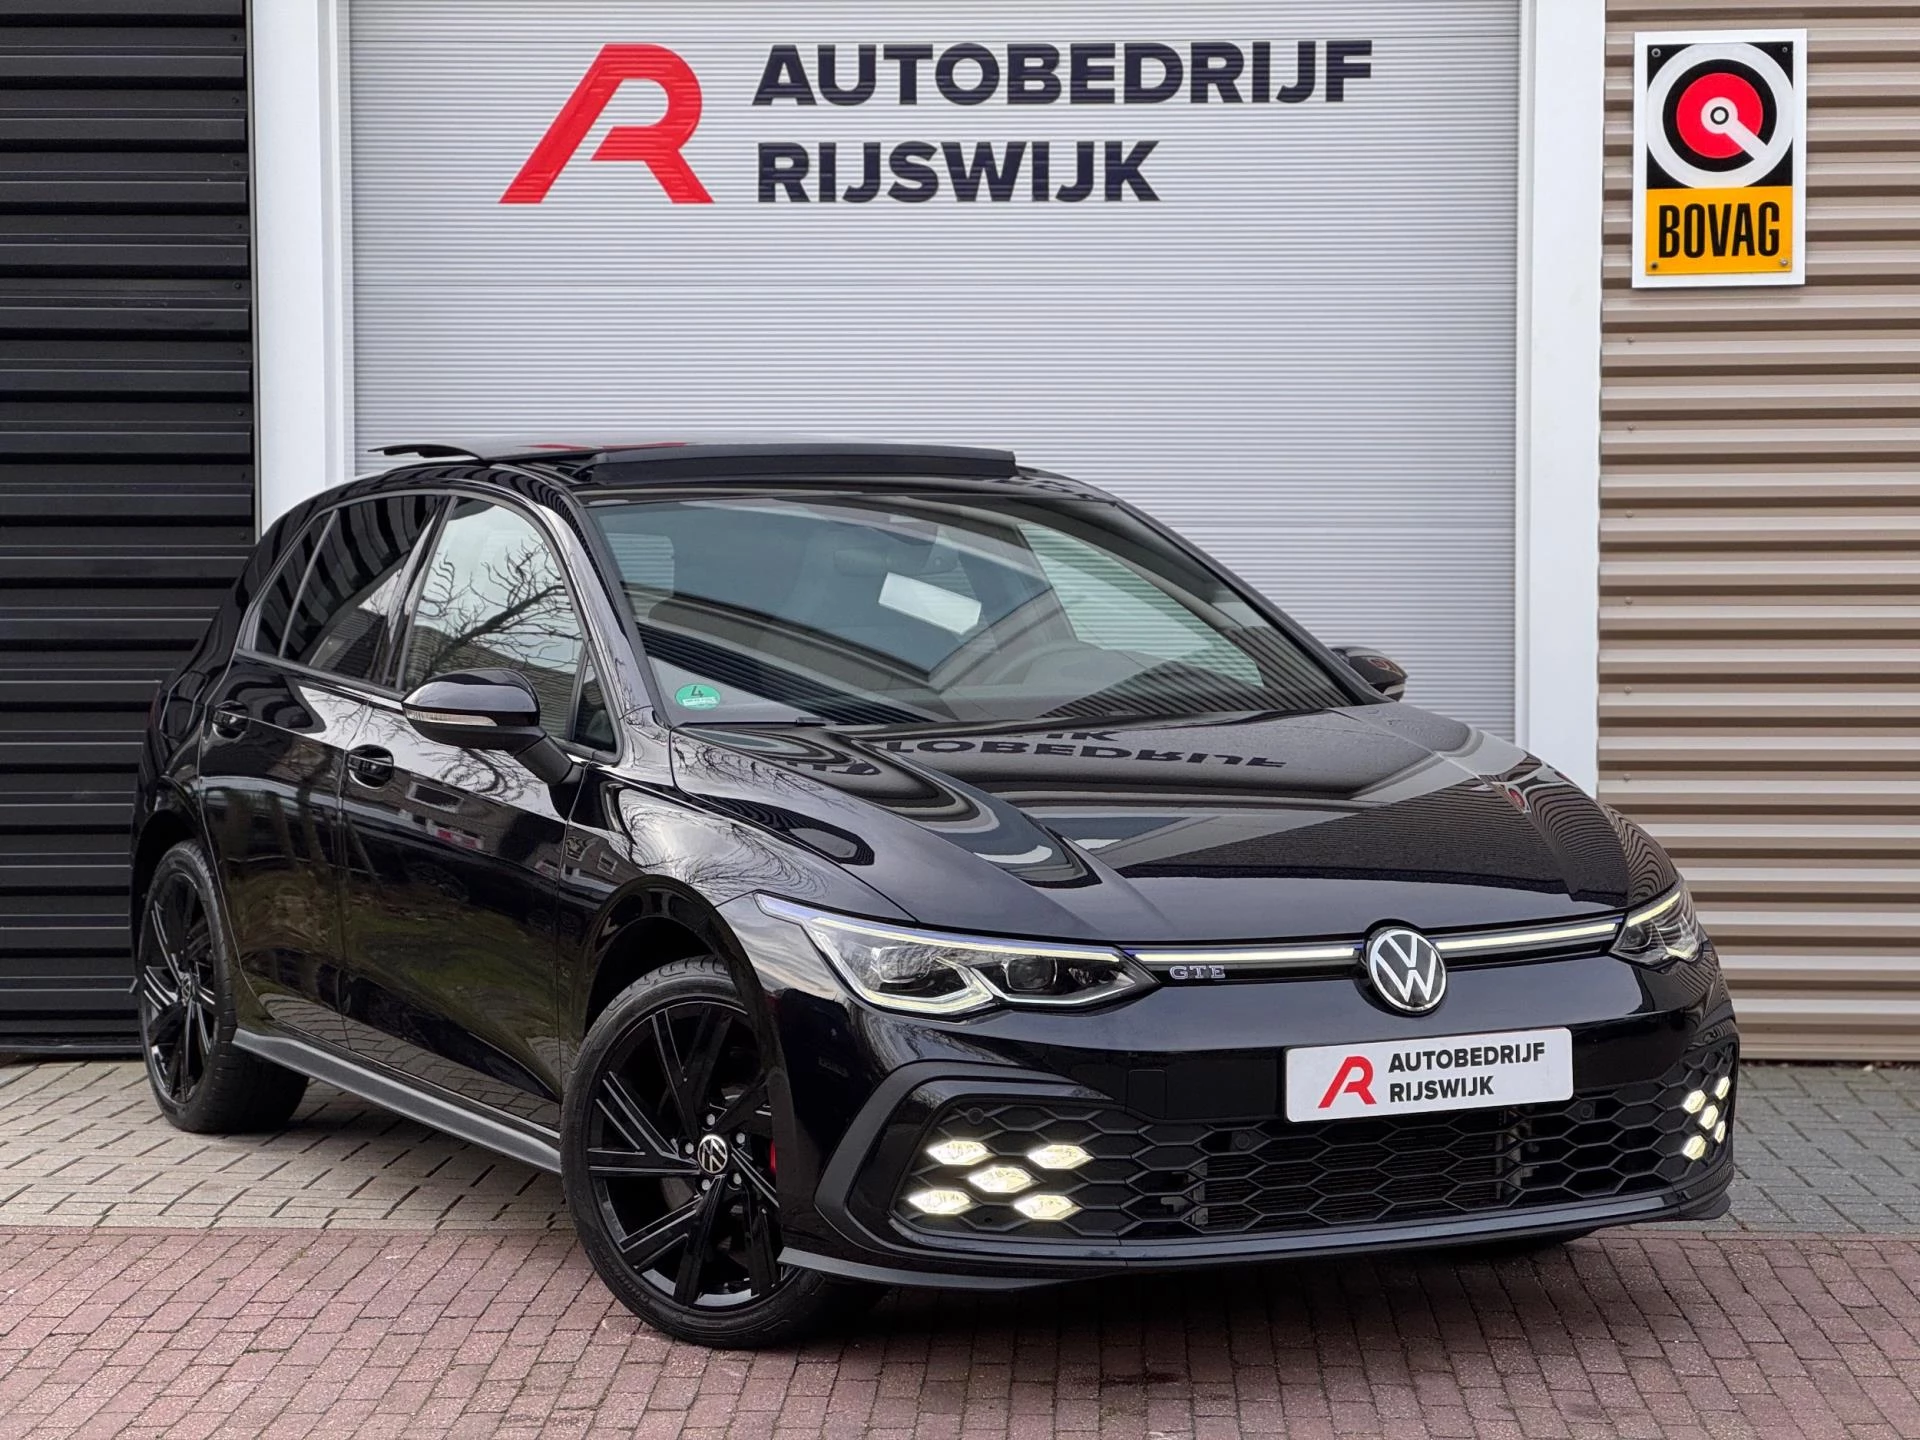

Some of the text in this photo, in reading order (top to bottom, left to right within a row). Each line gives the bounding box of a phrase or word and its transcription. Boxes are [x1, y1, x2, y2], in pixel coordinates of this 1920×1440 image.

[753, 40, 1372, 106] AUTOBEDRIJF
[758, 141, 1159, 203] RIJSWIJK
[1658, 201, 1780, 259] BOVAG
[1169, 964, 1226, 980] GTE
[1388, 1042, 1545, 1073] AUTOBEDRIJF
[1389, 1075, 1495, 1103] RIJSWIJK
